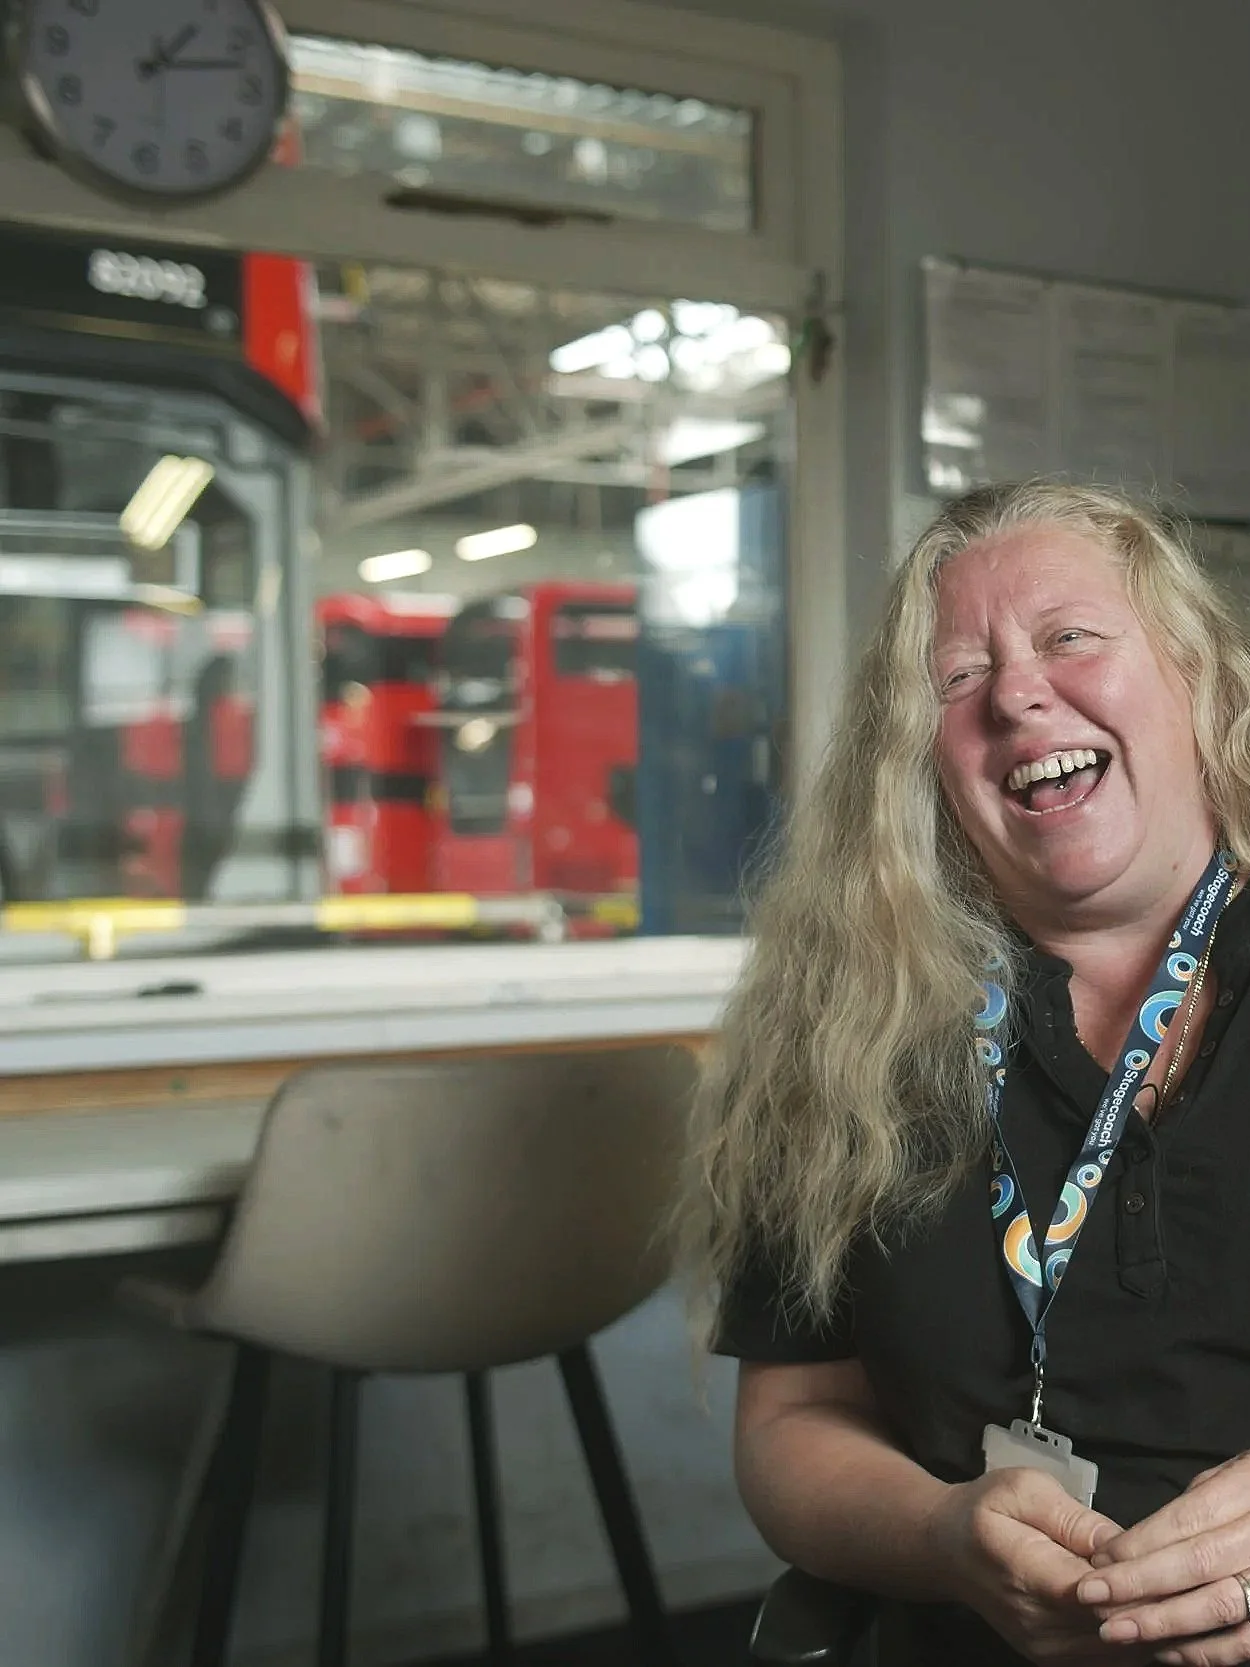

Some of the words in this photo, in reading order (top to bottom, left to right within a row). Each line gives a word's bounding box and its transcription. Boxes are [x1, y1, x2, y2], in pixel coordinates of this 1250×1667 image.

[1190, 868, 1229, 936] Stagecoach
[1094, 1118, 1102, 1132] got
[1098, 1069, 1139, 1147] Stagecoach
[1088, 1131, 1098, 1146] you
